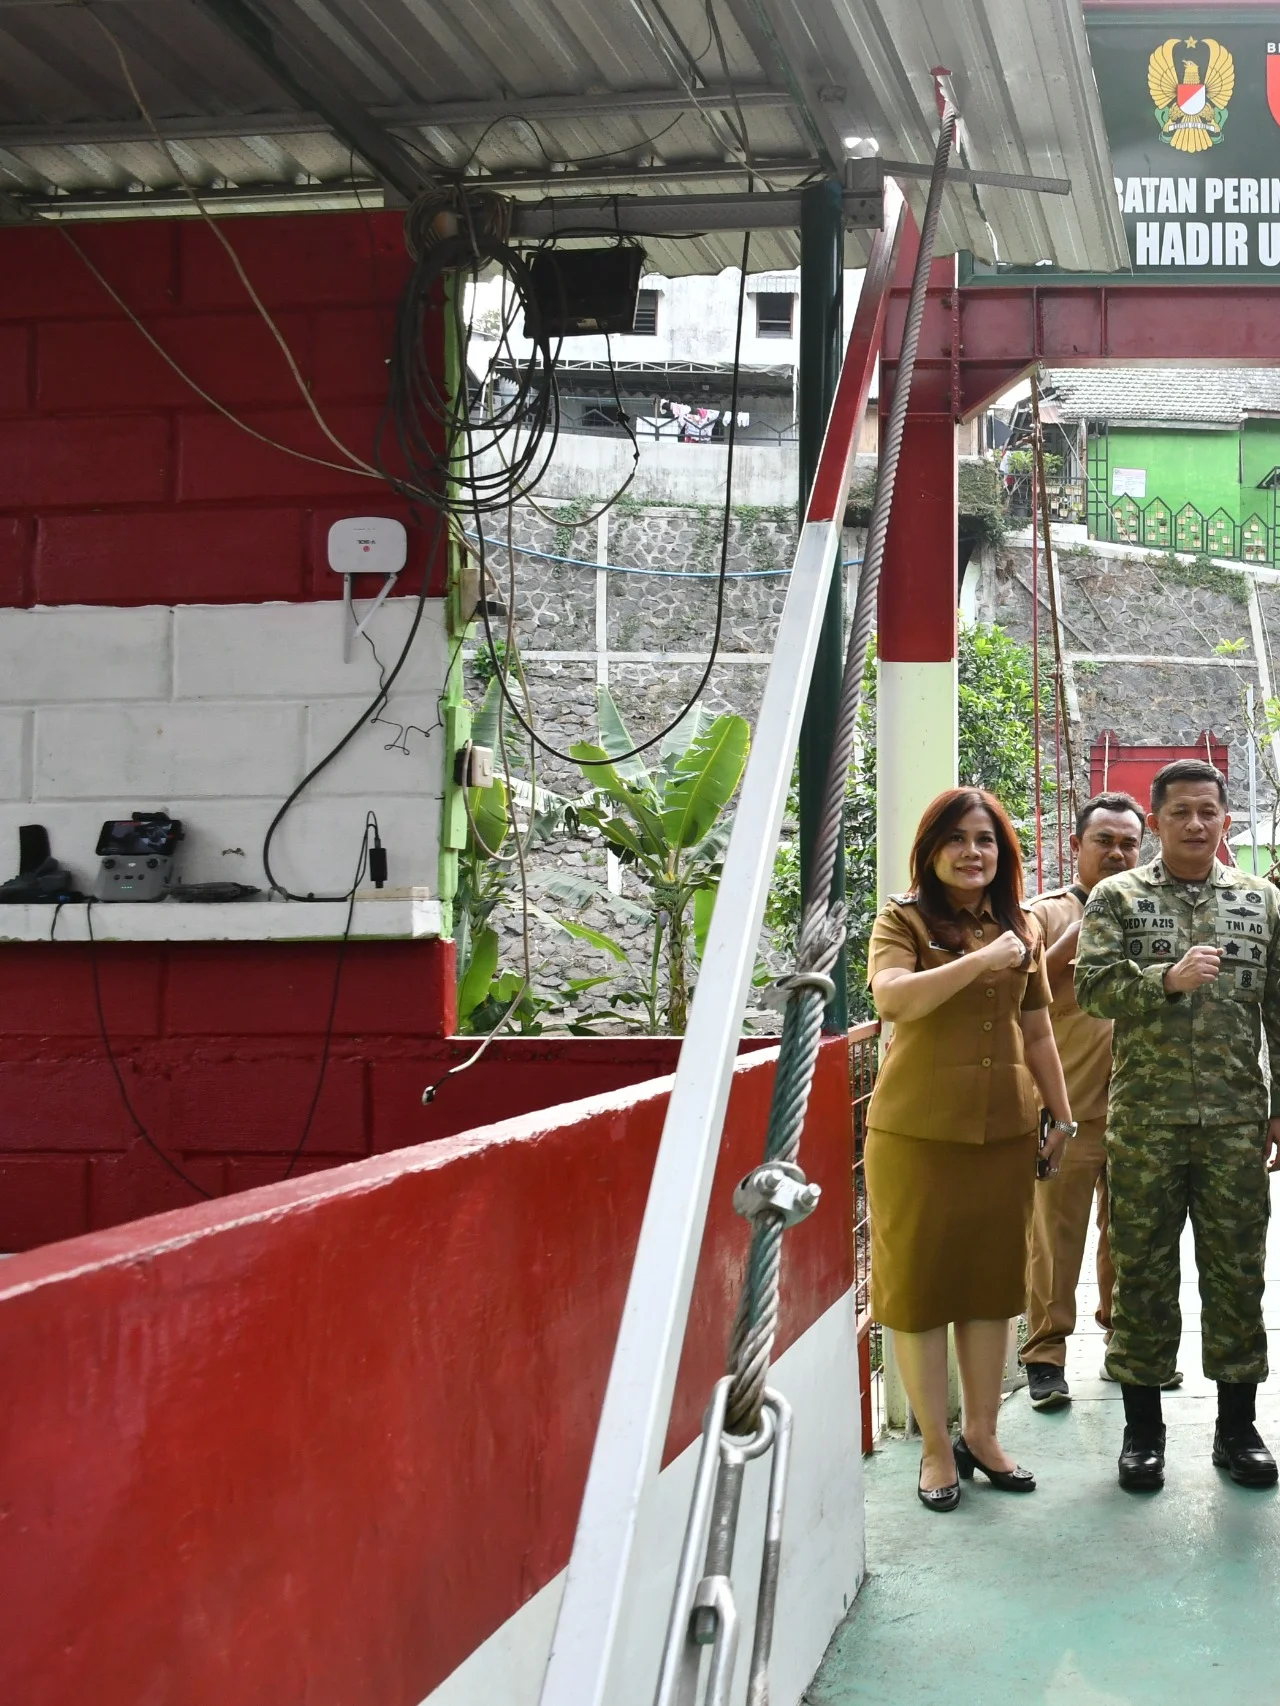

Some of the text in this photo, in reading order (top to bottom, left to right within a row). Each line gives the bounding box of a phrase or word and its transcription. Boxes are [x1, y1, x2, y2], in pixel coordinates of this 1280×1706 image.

[1136, 222, 1249, 265] HADIR
[1124, 917, 1175, 930] DEDY AZIS
[1225, 920, 1263, 935] TNI AD
